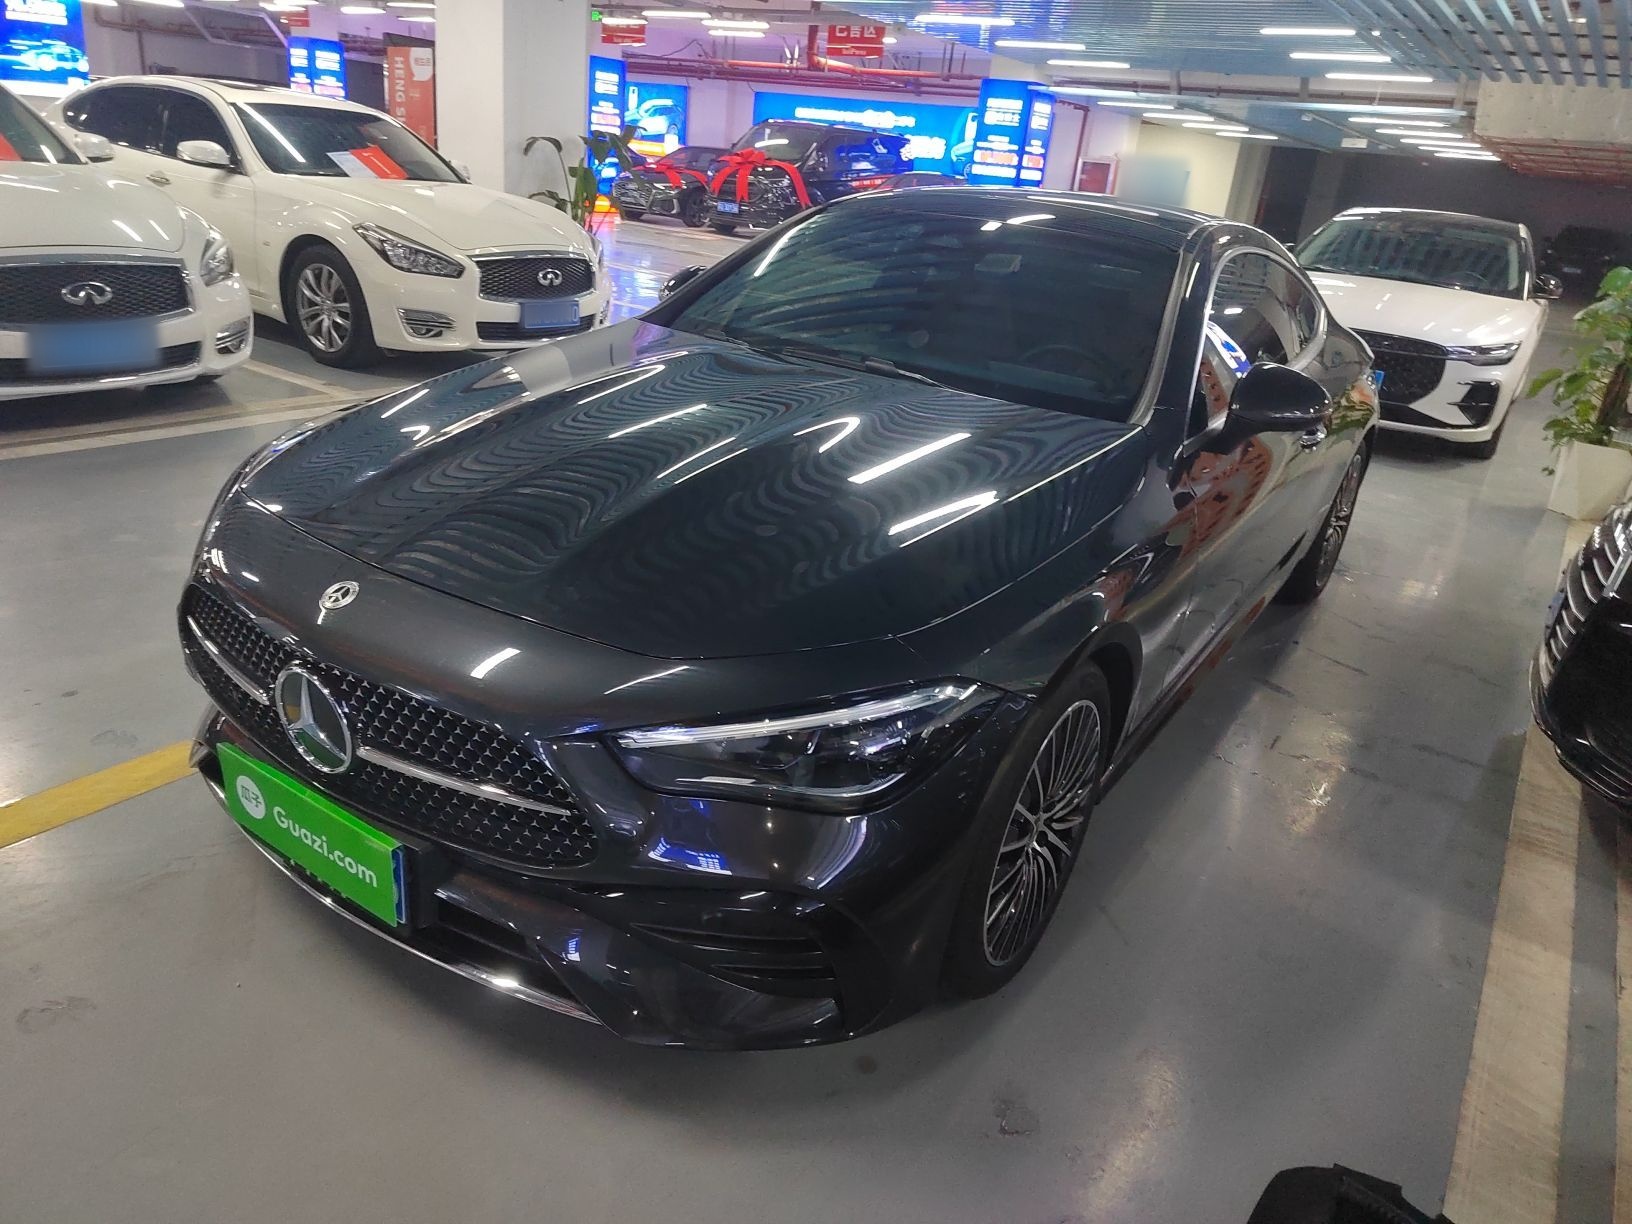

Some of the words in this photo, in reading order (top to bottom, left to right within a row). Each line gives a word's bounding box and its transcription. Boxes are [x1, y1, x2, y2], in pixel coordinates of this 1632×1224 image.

[394, 56, 406, 102] HENG
[241, 785, 263, 808] 瓜子
[272, 806, 378, 887] Guazi.com
